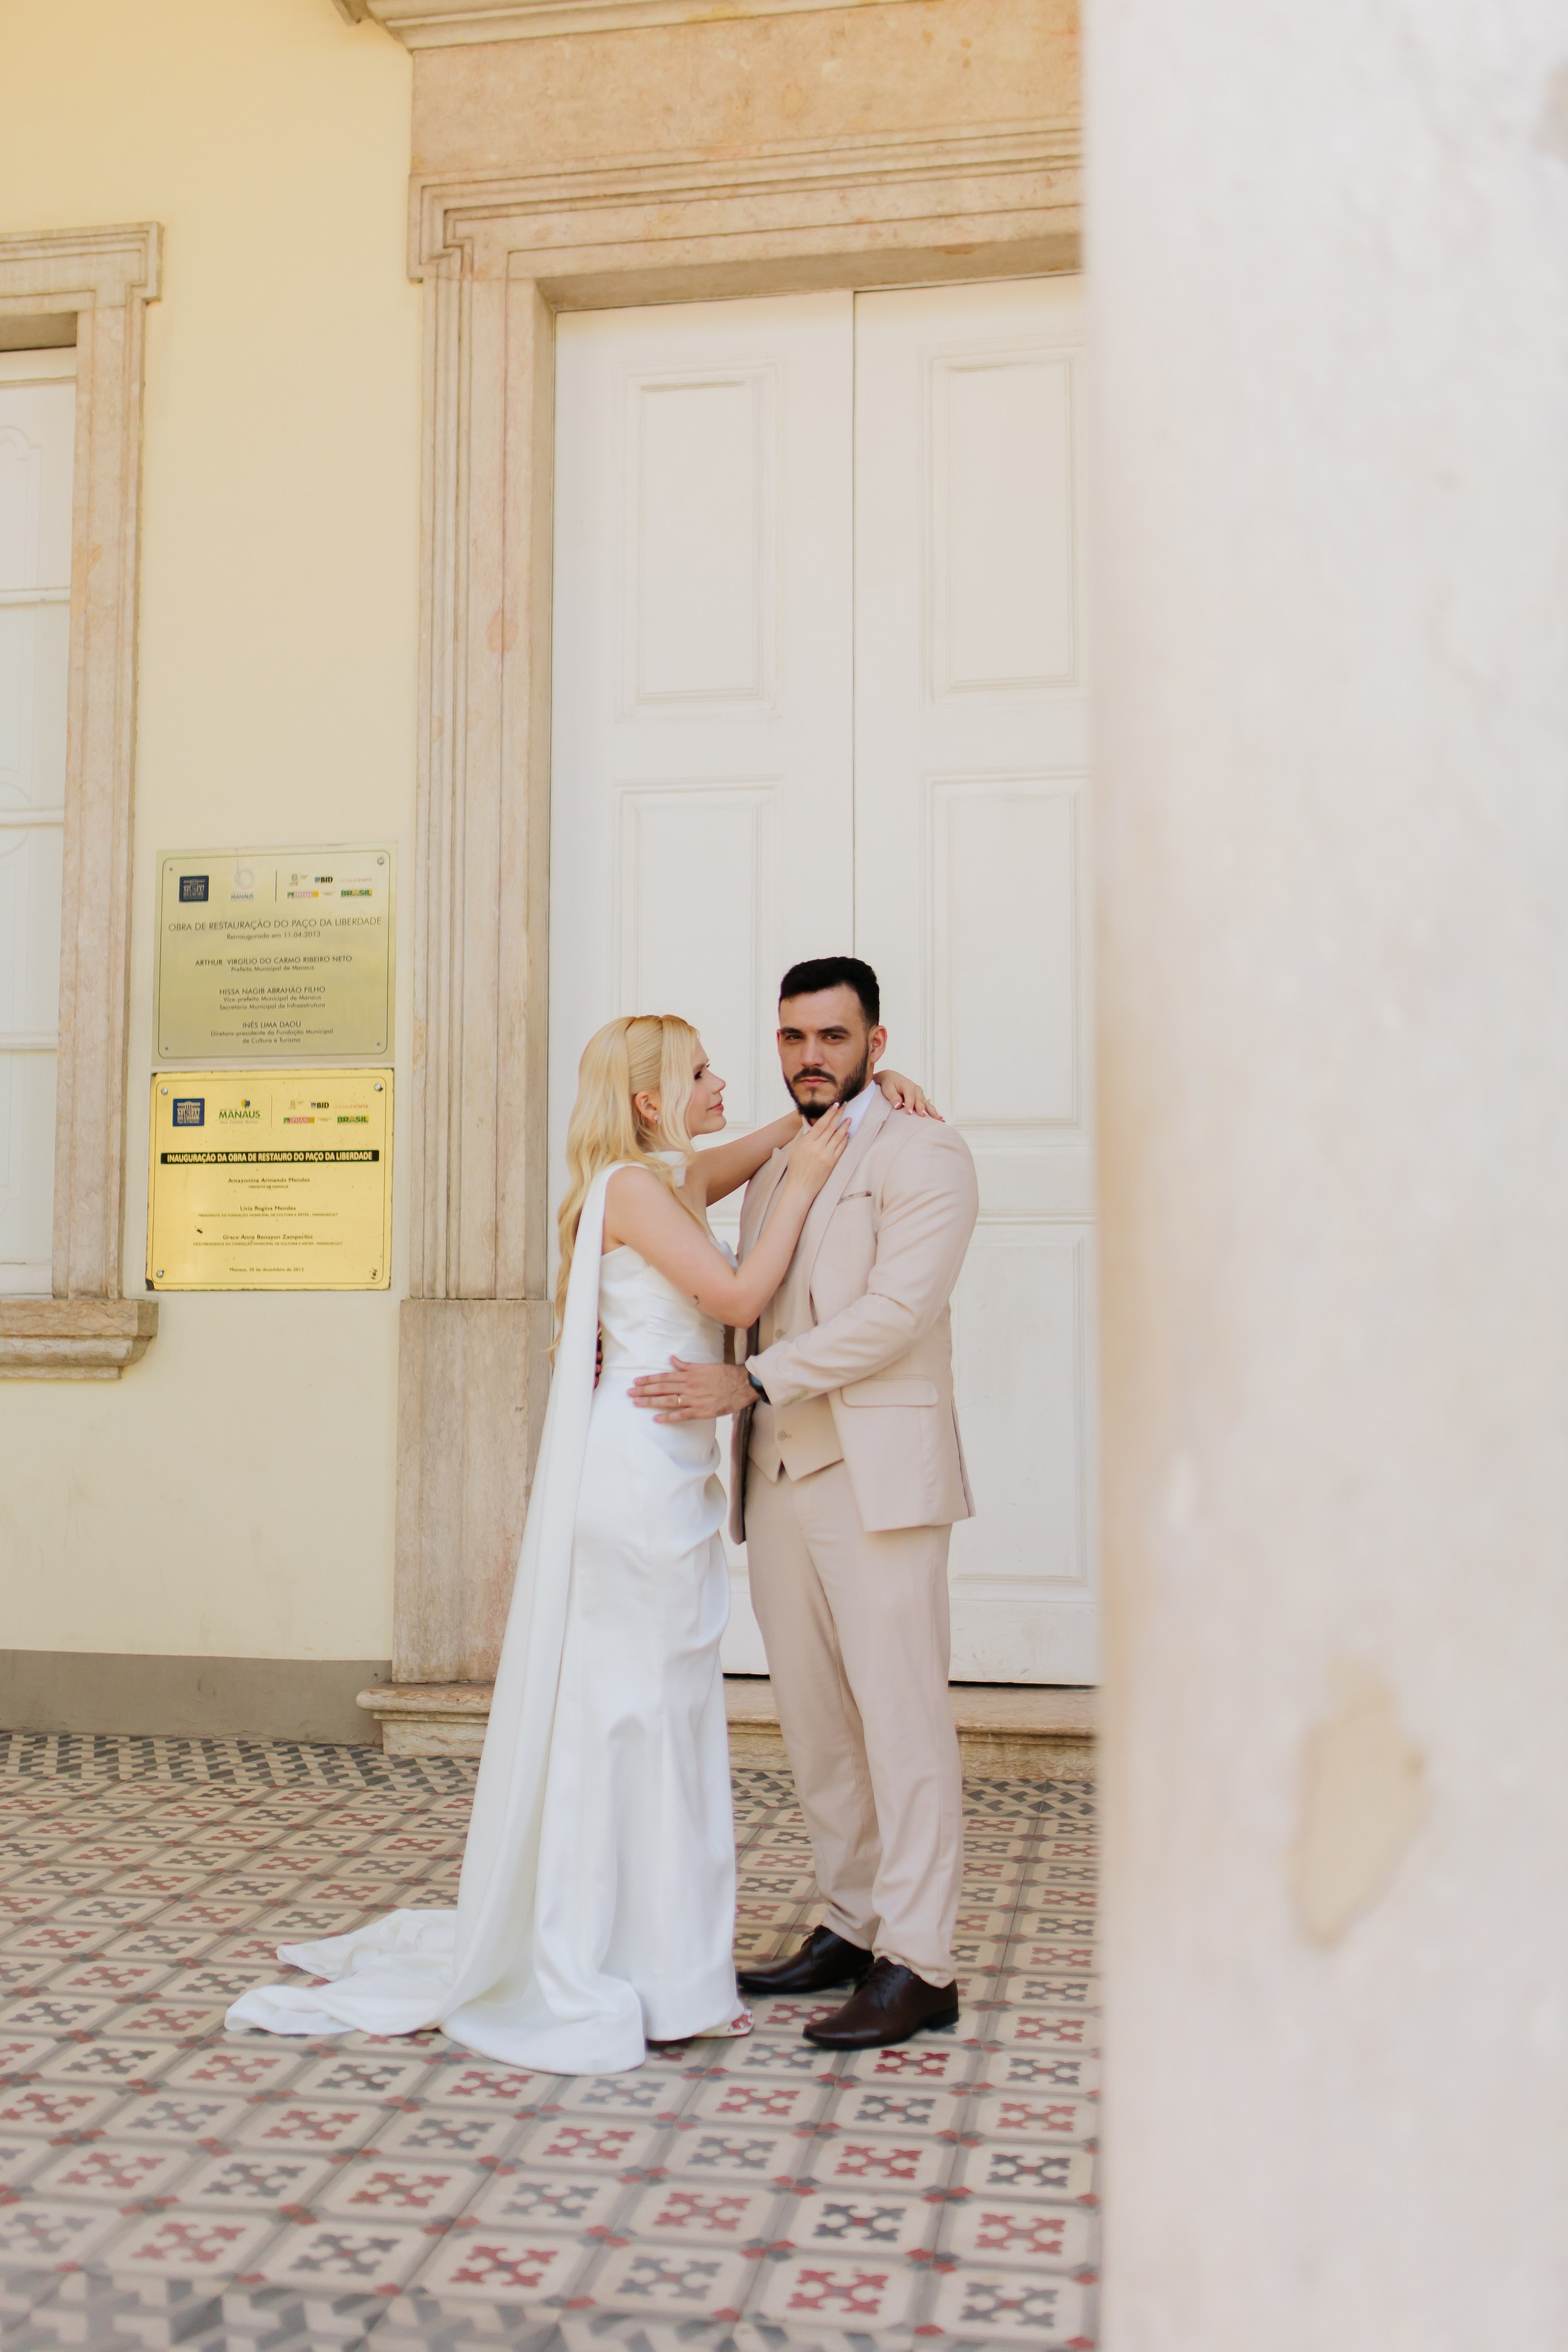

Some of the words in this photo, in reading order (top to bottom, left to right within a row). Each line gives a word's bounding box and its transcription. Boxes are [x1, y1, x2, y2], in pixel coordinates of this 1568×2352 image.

[168, 923, 192, 932] OBRA
[195, 922, 206, 931] DE
[209, 918, 271, 931] RESTAURAÇÃO
[274, 920, 288, 929] DO
[292, 919, 317, 929] PAÇO
[335, 918, 381, 926] LIBERDADE
[227, 932, 269, 941] Reinaugurada
[242, 1020, 258, 1028] INÊS
[167, 1153, 216, 1163] INAUGURAÇÃO
[217, 1153, 227, 1162] DA
[228, 1153, 246, 1162] OBRA
[248, 1153, 257, 1162] DE
[258, 1152, 292, 1162] RESTAURO
[293, 1152, 304, 1161] DO
[306, 1152, 323, 1163] PAÇO
[325, 1152, 335, 1161] DA
[336, 1152, 372, 1161] LIBERDADE
